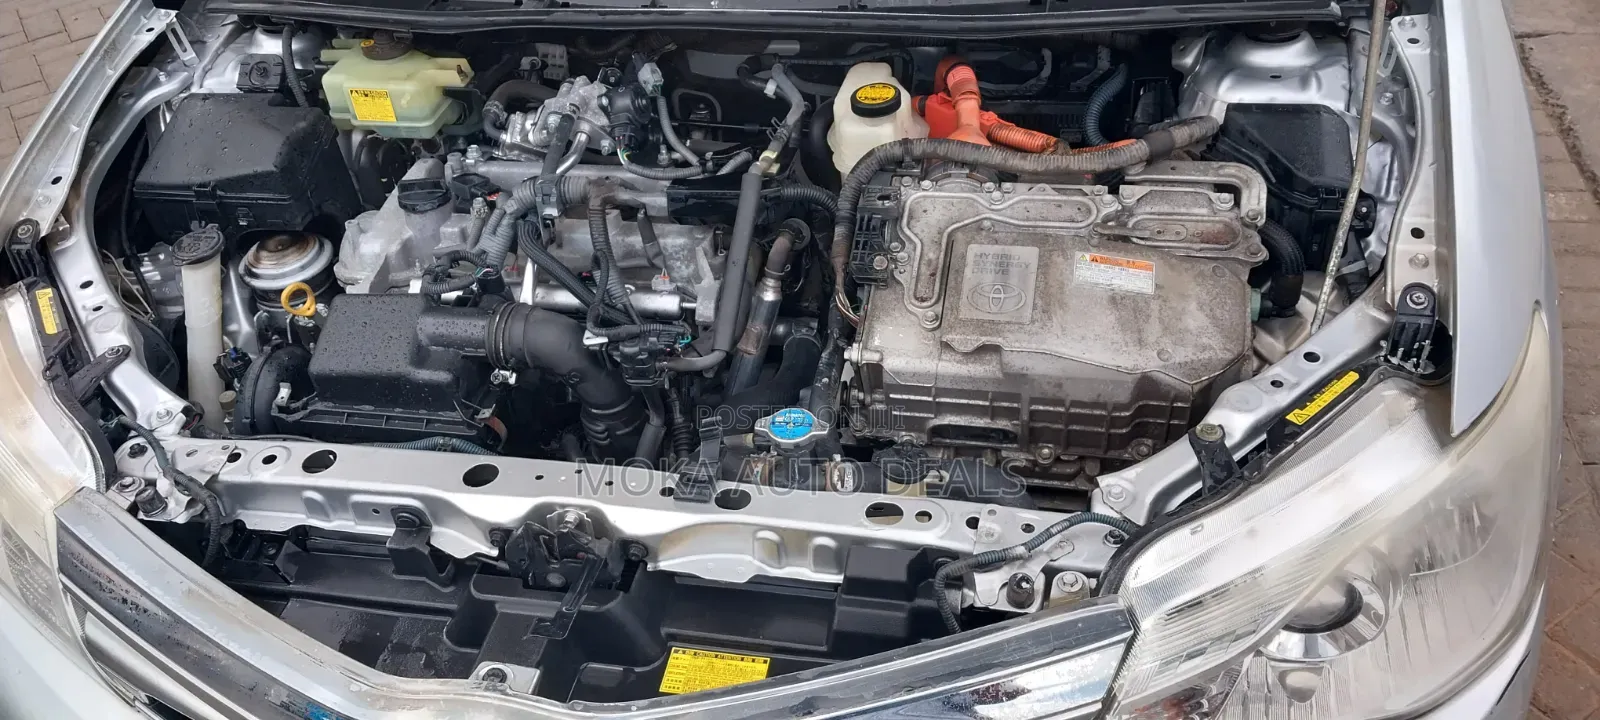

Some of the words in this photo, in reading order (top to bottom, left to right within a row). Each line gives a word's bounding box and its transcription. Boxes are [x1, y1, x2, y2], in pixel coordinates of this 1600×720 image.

[974, 253, 1021, 261] HYBRID
[972, 260, 1032, 269] SYNERGY
[971, 268, 1010, 276] DRIVE
